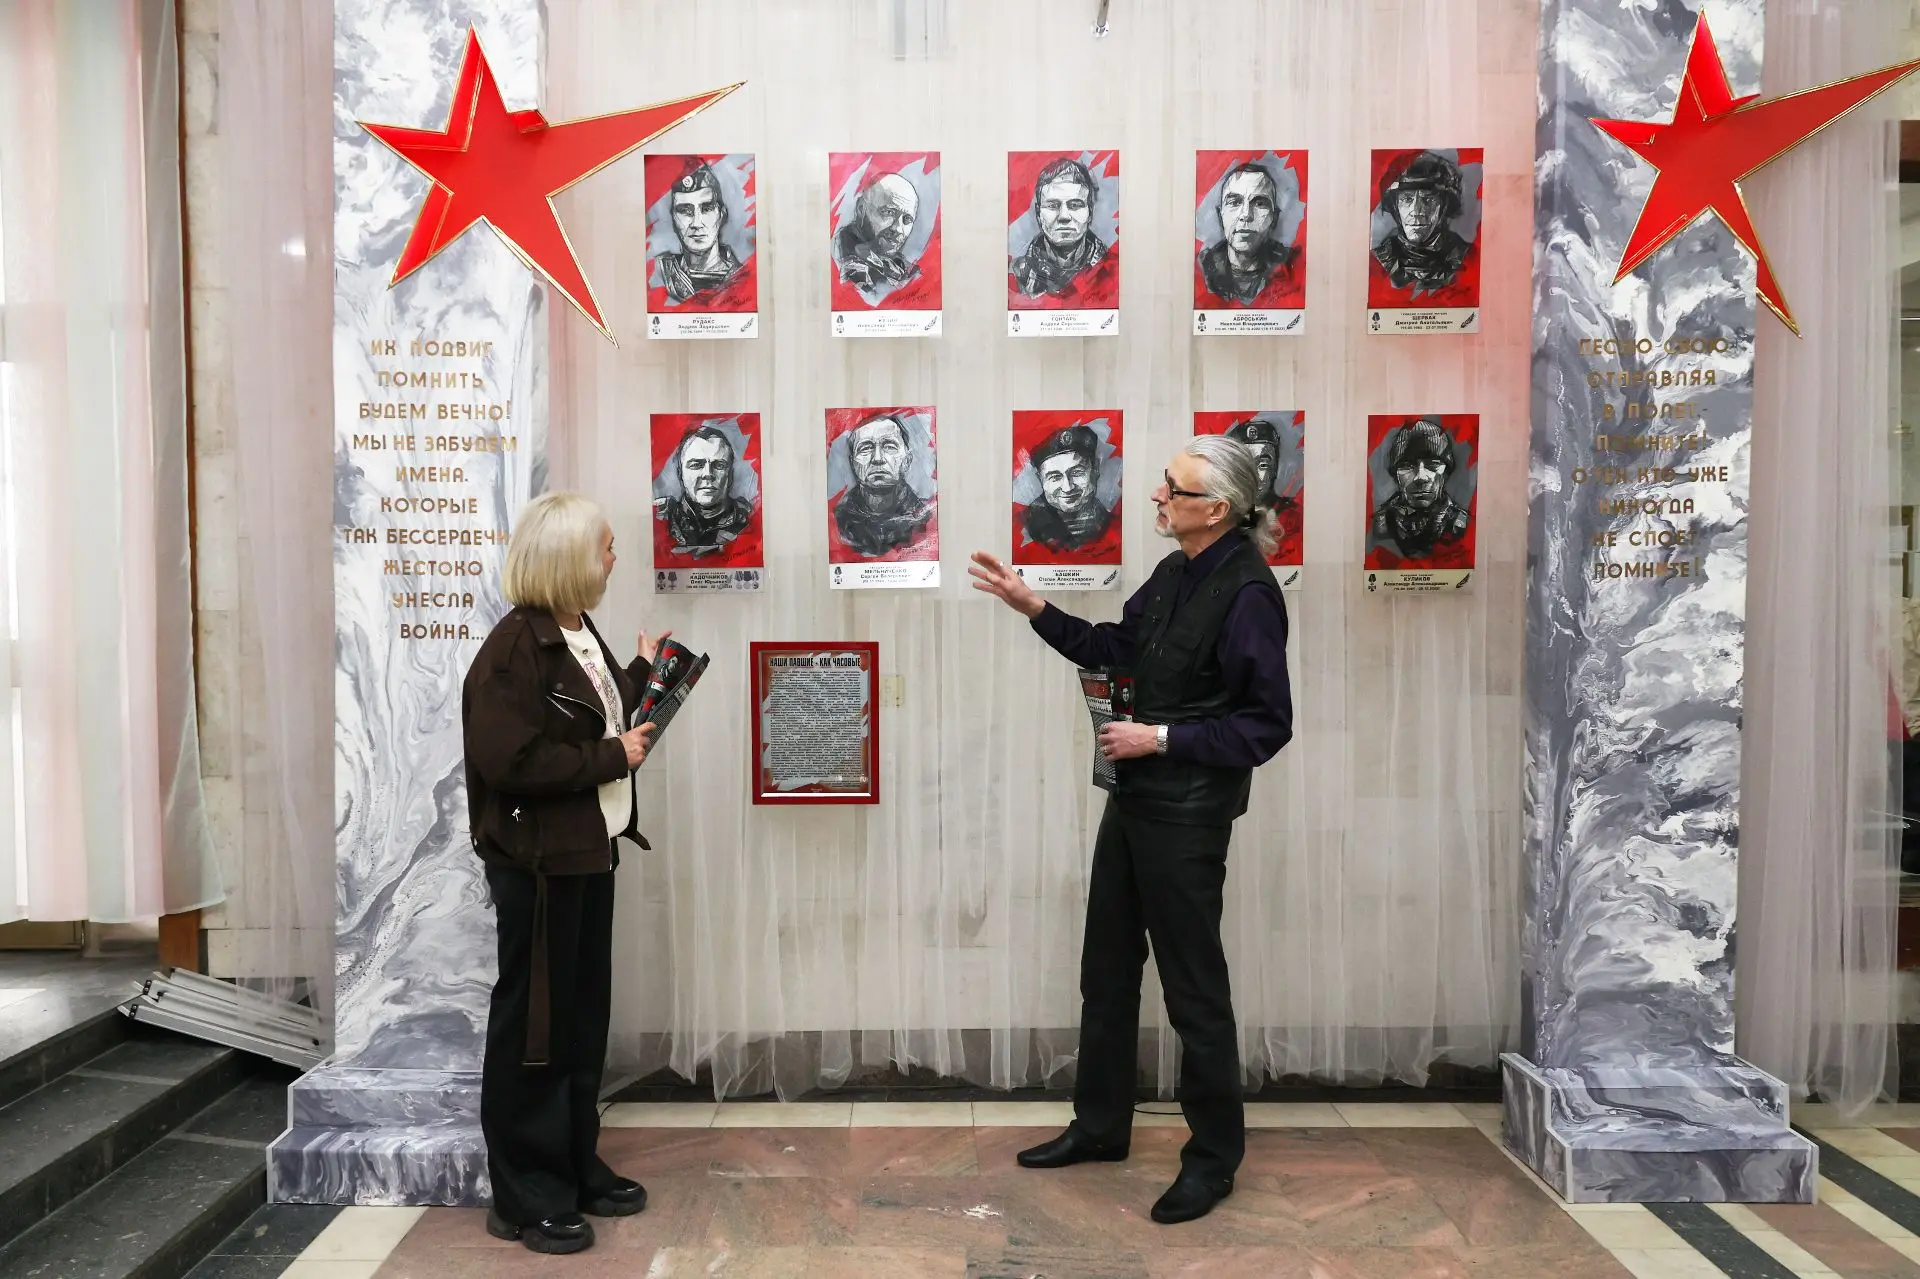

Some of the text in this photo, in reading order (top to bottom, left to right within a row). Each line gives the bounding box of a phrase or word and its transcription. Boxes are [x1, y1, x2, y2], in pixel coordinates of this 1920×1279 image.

[371, 340, 493, 357] ИХ ПОДВИГ
[377, 371, 484, 388] ПОМНИТЬ
[1587, 369, 1716, 388] ОТПРАВЛЯЯ
[359, 401, 511, 420] БУДЕМ ВЕЧНО!
[1603, 403, 1615, 420] В
[353, 434, 518, 452] МЫ НЕ ЗАБУДЕМ
[1572, 468, 1587, 484] О
[1638, 467, 1676, 483] КТО
[1688, 466, 1728, 482] УЖЕ
[381, 497, 478, 514] КОТОРЫЕ
[1599, 498, 1694, 515] НИКОГДА
[344, 528, 511, 545] ТАК БЕССЕРДЕЧН
[1592, 529, 1697, 547] НЕ СПОЕТ
[383, 559, 483, 576] ЖЕСТОКО
[1594, 557, 1700, 579] ПОМНИТЕ!
[392, 592, 474, 608] УНЕСЛА
[769, 657, 788, 667] НАШИ
[789, 657, 814, 667] ПАВШИЕ
[819, 657, 832, 667] КАК
[832, 657, 861, 667] ЧАСОВЫЕ
